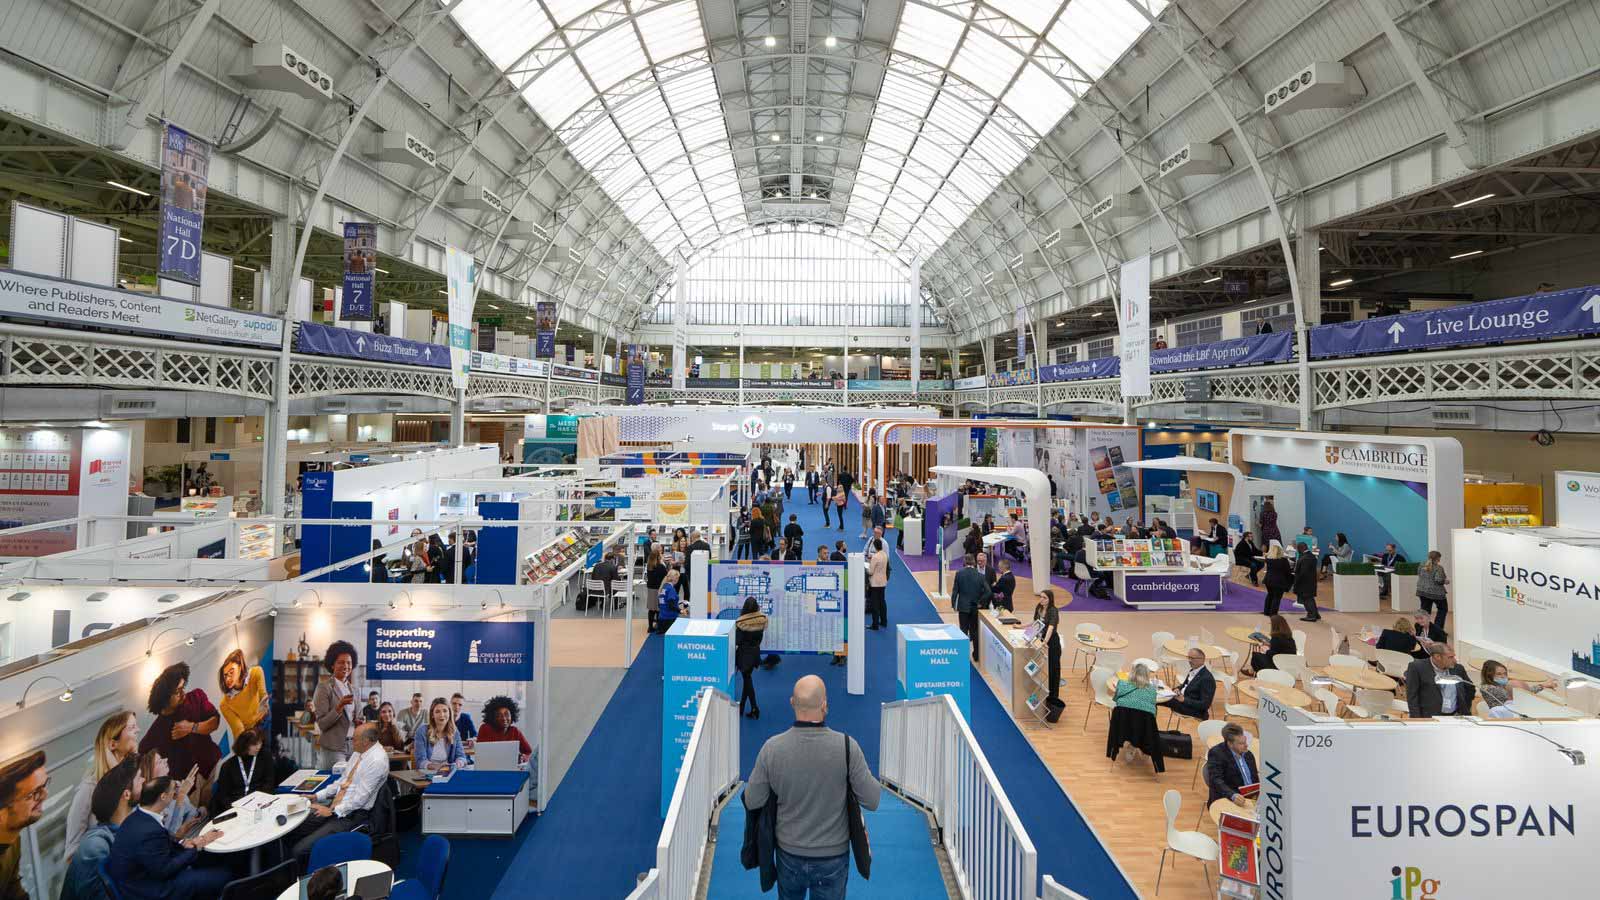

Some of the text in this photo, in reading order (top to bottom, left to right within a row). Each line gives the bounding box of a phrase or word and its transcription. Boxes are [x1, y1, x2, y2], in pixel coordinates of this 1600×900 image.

[167, 211, 200, 229] National
[174, 226, 190, 238] Hall
[168, 236, 196, 260] 7D
[0, 280, 161, 314] Where Publishers, Content
[353, 290, 362, 303] 7
[28, 300, 140, 323] and Readers Meet
[196, 312, 239, 328] NetGalley
[1426, 309, 1549, 336] Live Lounge
[374, 340, 418, 356] Buzz Theatre
[543, 340, 548, 348] 7
[1150, 352, 1182, 366] Download
[1183, 352, 1195, 362] the
[1196, 350, 1210, 360] LBF
[1212, 348, 1228, 360] App
[1230, 346, 1250, 356] now
[1341, 448, 1428, 466] CAMBRIDGE
[1132, 581, 1200, 594] cambridge.org
[376, 628, 436, 639] Supporting
[376, 640, 432, 650] Educators,
[376, 651, 422, 662] Inspiring
[376, 662, 426, 672] Students.
[1261, 698, 1288, 722] 7D26
[1296, 736, 1332, 748] 7D26
[1352, 804, 1575, 838] EUROSPAN
[1265, 760, 1284, 900] ROSPAN
